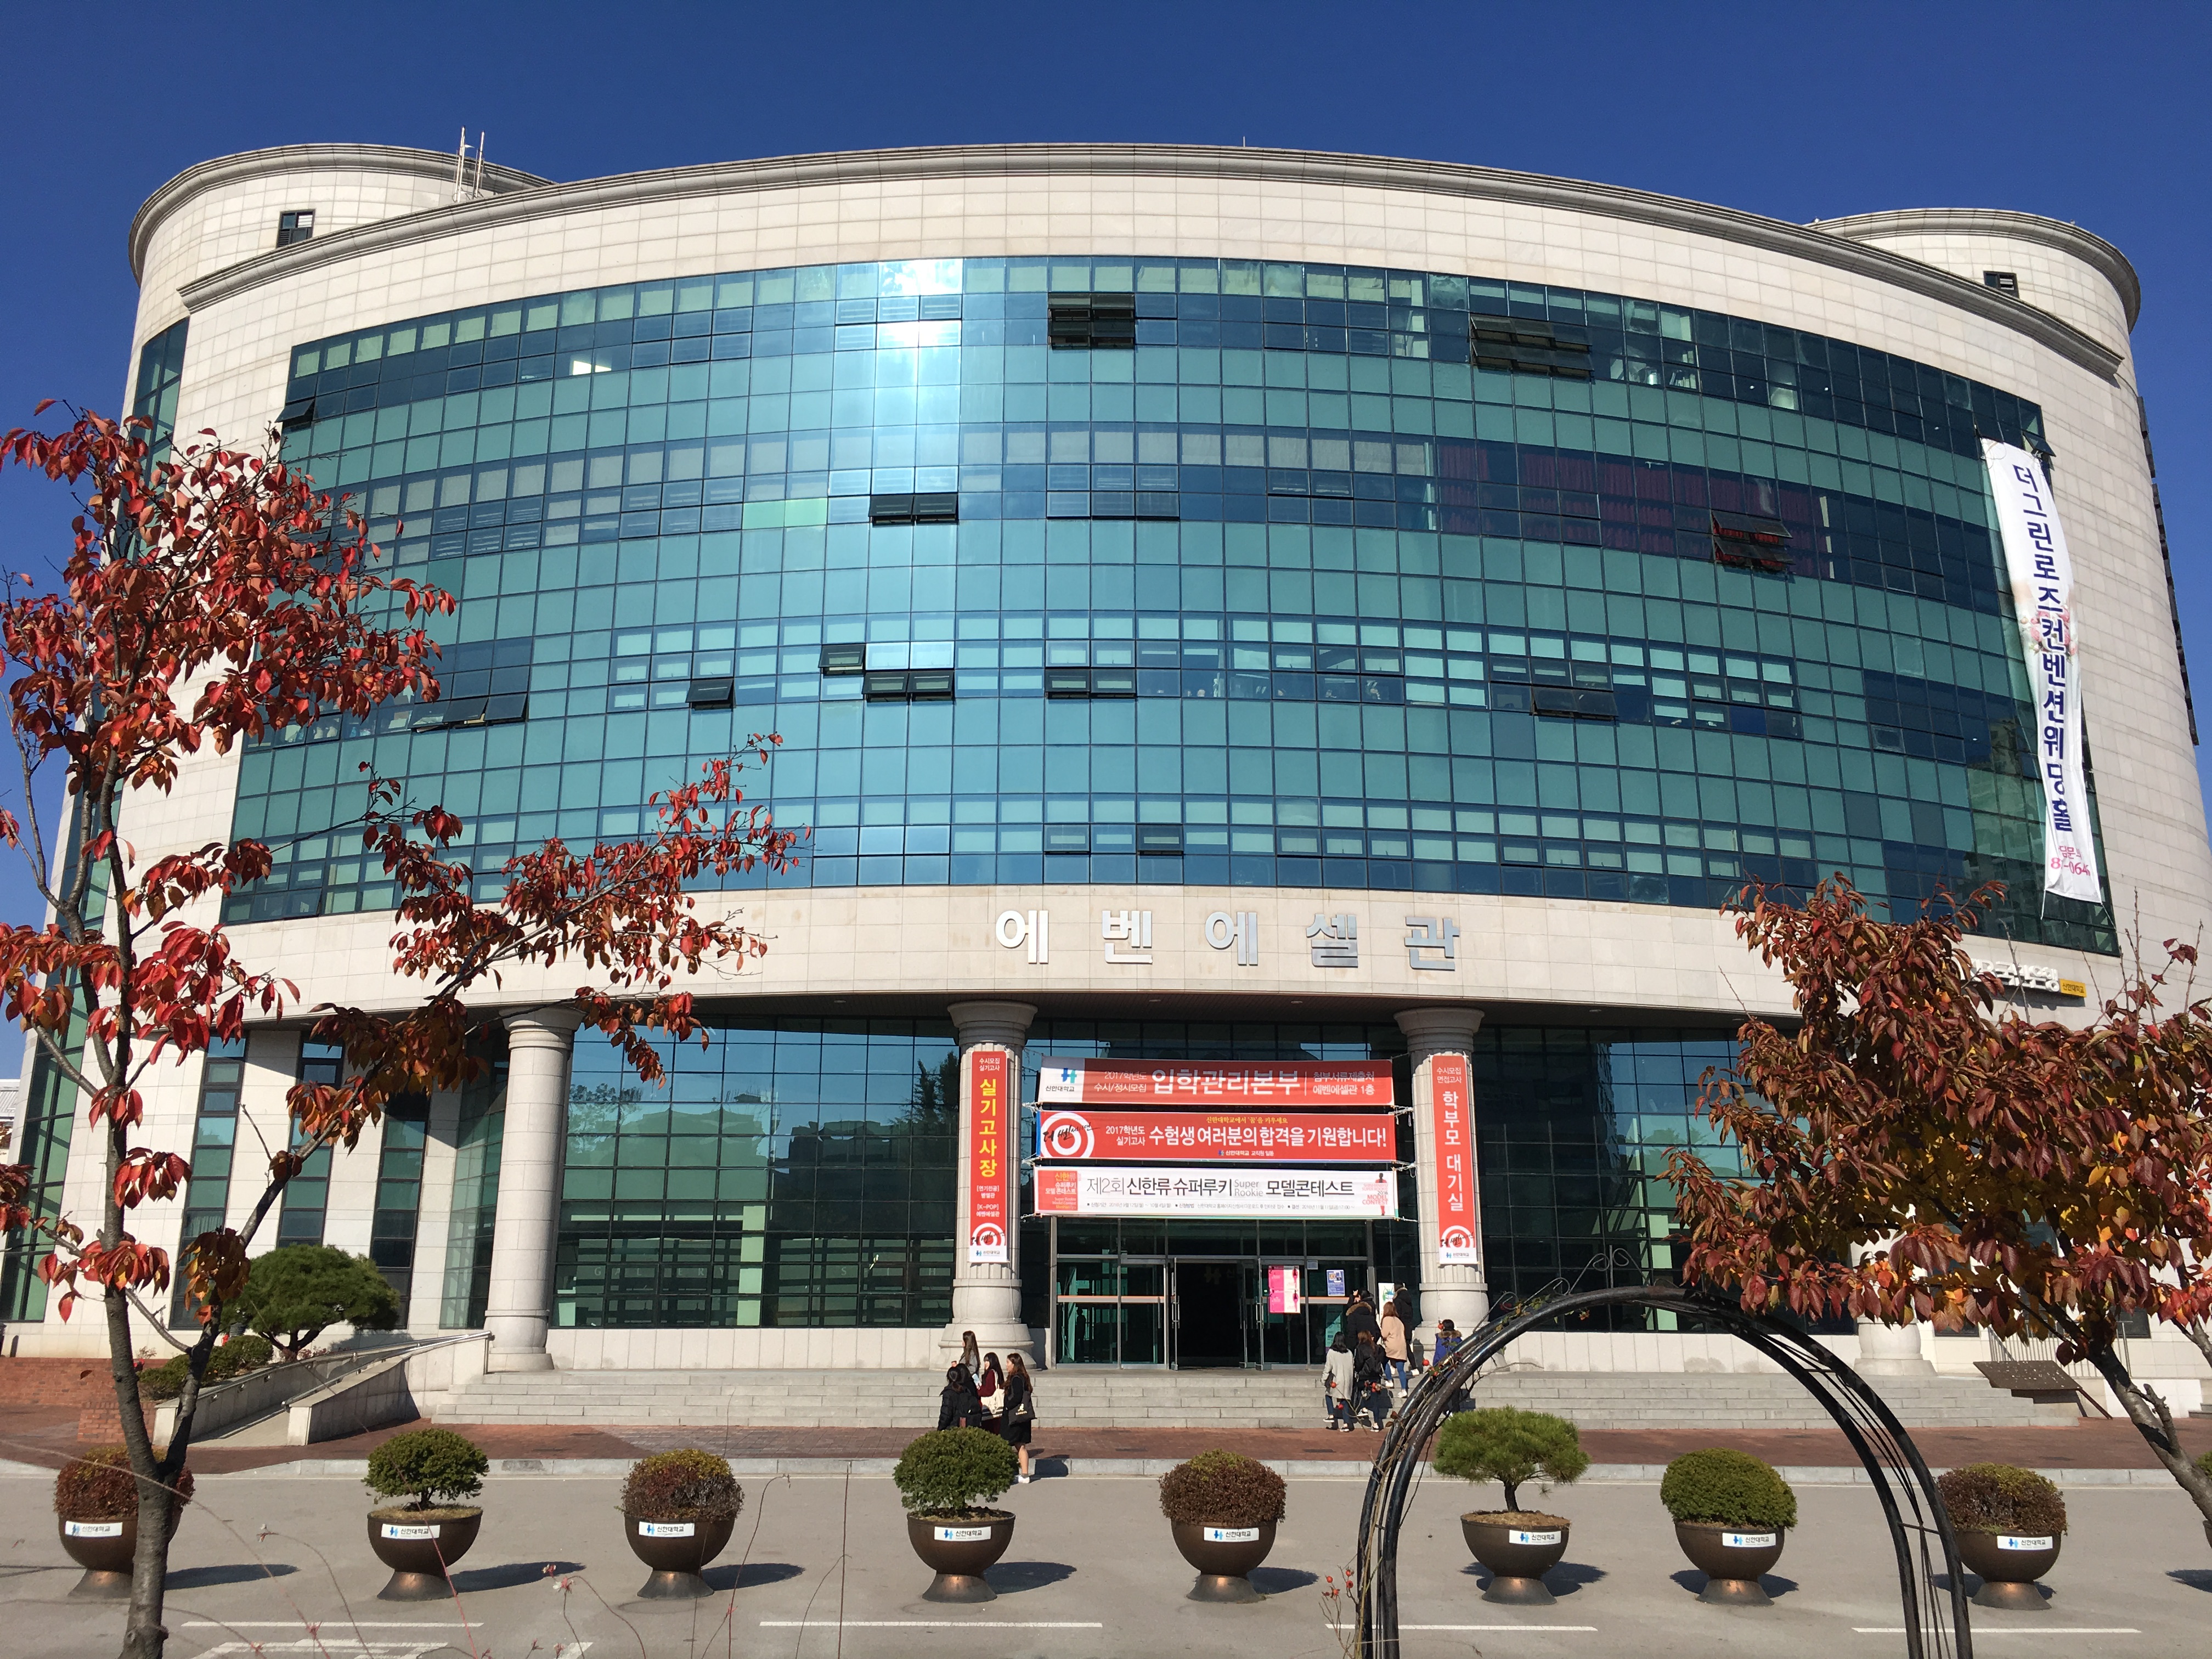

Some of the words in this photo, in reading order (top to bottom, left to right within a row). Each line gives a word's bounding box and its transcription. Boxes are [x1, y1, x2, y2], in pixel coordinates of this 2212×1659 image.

[995, 910, 1460, 971] 에벤에셀관
[2062, 983, 2084, 993] 신한대학교
[1104, 1071, 1147, 1080] 2017학년도
[1313, 1071, 1375, 1082] 첨부서류제출처
[1093, 1083, 1147, 1092] 수시/정시모집
[1152, 1069, 1300, 1095] 입학관리본부
[1313, 1084, 1357, 1095] 에벤에셀관
[1361, 1084, 1375, 1095] 1층
[1442, 1091, 1461, 1145] 학부모
[979, 1079, 997, 1177] 실기고사장
[1105, 1125, 1146, 1135] 2017학년도
[1116, 1136, 1146, 1146] 실기고사
[1149, 1126, 1195, 1146] 수험생
[1197, 1126, 1257, 1146] 여러분의
[1259, 1127, 1305, 1147] 합격을
[1307, 1127, 1386, 1147] 기원합니다!
[1055, 1172, 1076, 1181] 신한류
[1087, 1177, 1124, 1195] 제2회
[1127, 1177, 1171, 1195] 신한류
[1173, 1178, 1232, 1196] 슈퍼루키
[1234, 1180, 1259, 1189] Super
[1446, 1154, 1463, 1211] 대기실
[1234, 1188, 1263, 1197] Rookie
[1266, 1180, 1355, 1197] 모델콘테스트
